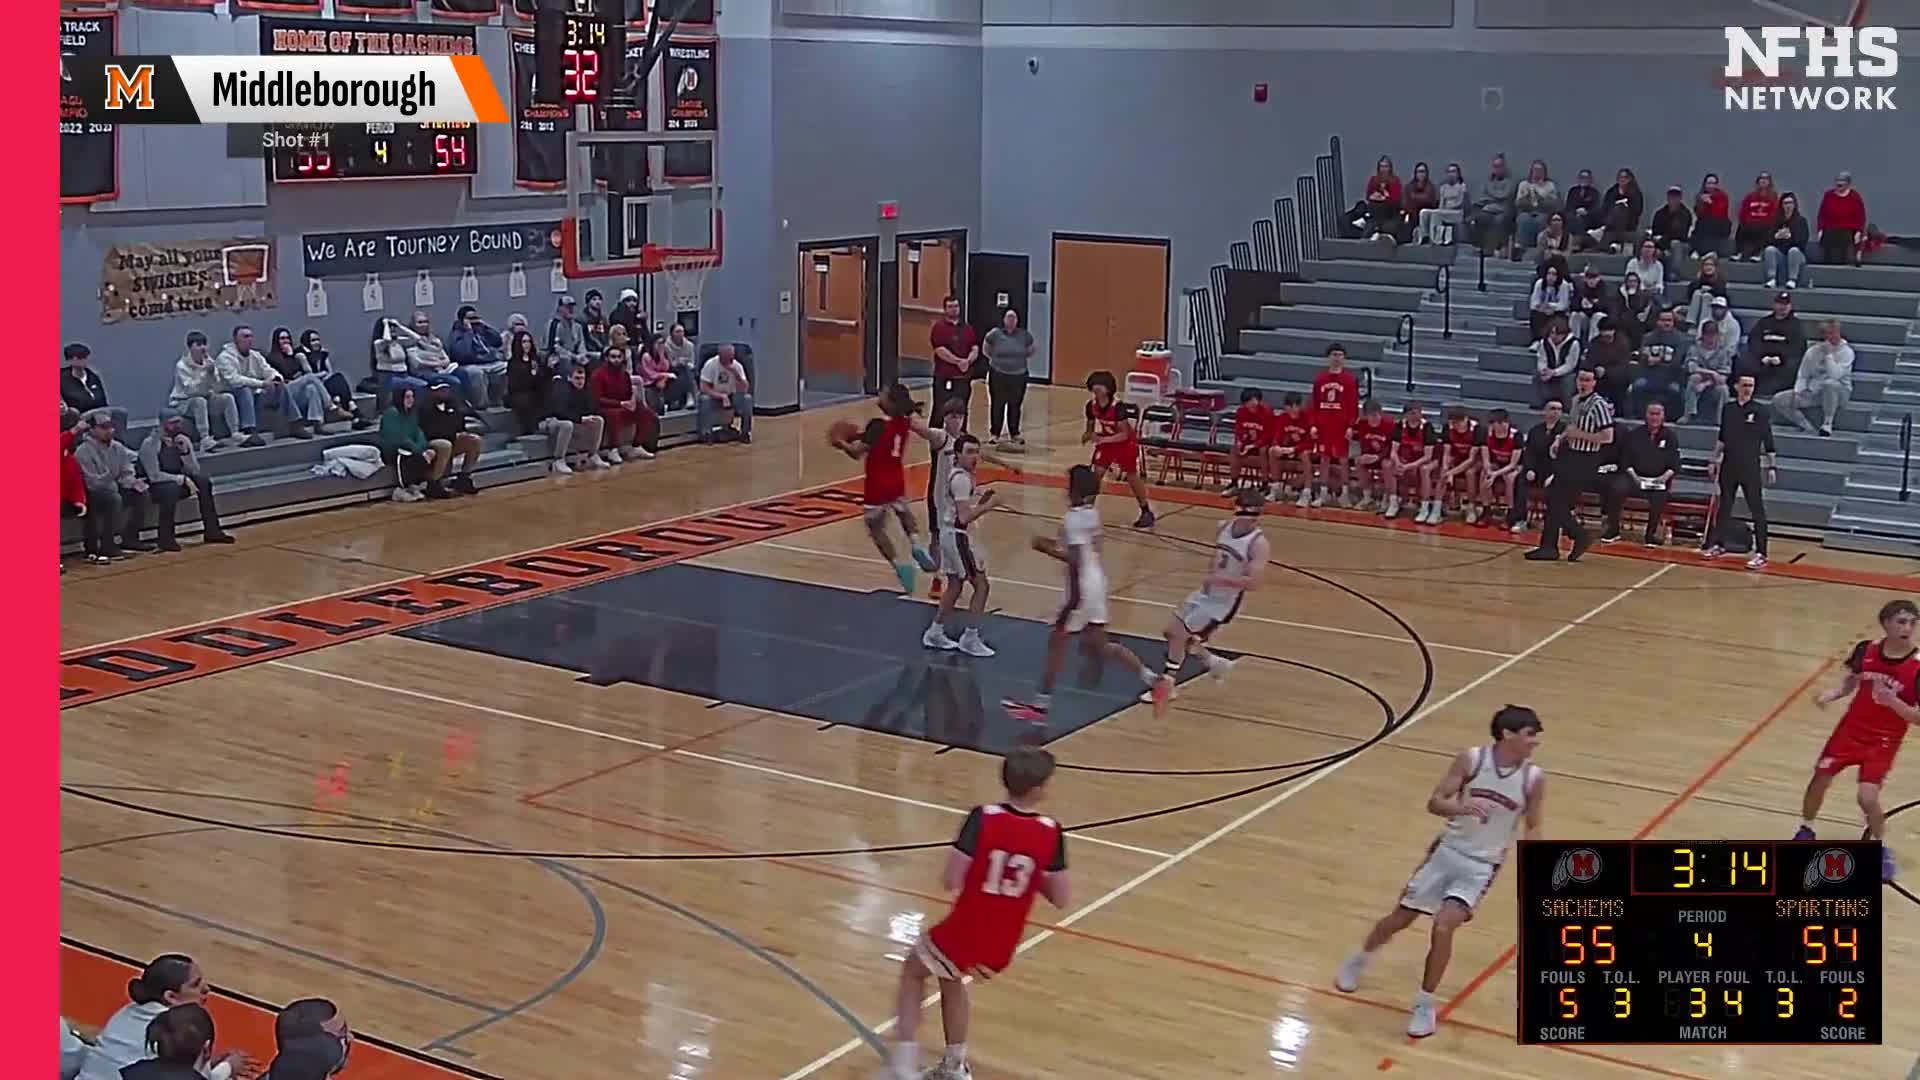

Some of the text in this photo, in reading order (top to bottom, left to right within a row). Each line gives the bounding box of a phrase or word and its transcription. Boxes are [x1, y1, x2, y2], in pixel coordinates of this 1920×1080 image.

[64, 21, 100, 33] TRACK
[568, 20, 604, 45] 3:14
[273, 29, 474, 55] HOME OF THE SACHEMS
[669, 48, 710, 59] WRESTLING
[564, 49, 598, 95] 32
[374, 140, 388, 164] 4
[435, 134, 466, 168] 54
[120, 254, 153, 271] May
[159, 248, 179, 266] all
[307, 240, 337, 261] We
[345, 238, 376, 257] Are
[981, 849, 1036, 898] 13
